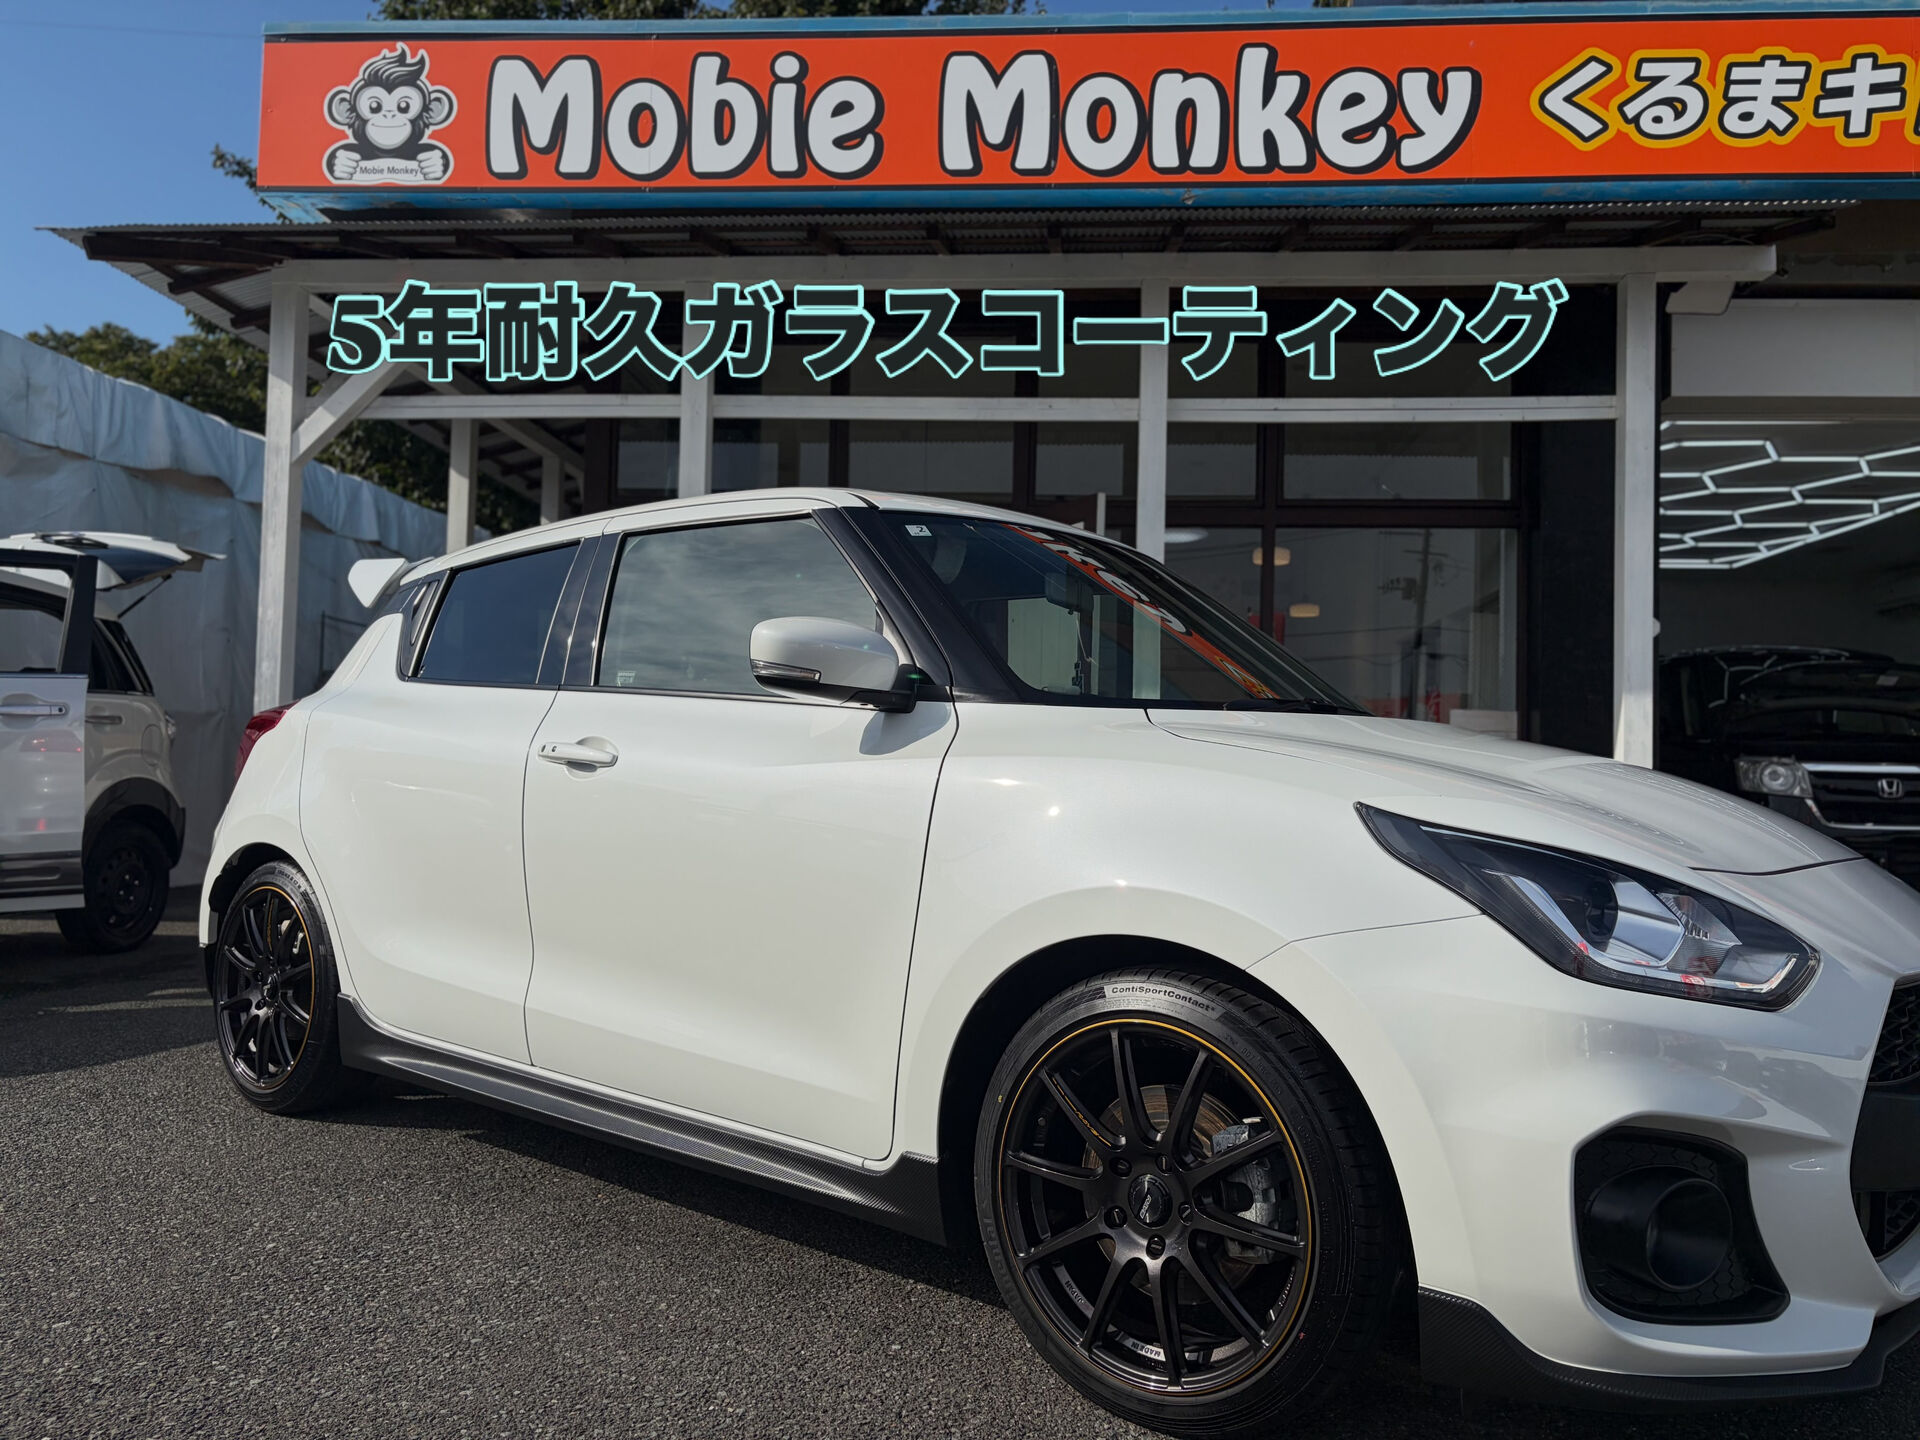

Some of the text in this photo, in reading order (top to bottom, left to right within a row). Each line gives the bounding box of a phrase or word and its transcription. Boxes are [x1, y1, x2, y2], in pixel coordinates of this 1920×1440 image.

[486, 42, 1480, 180] Mobie Monkey
[1537, 52, 1920, 142] くるまキ
[360, 165, 419, 177] Mobie Monkey
